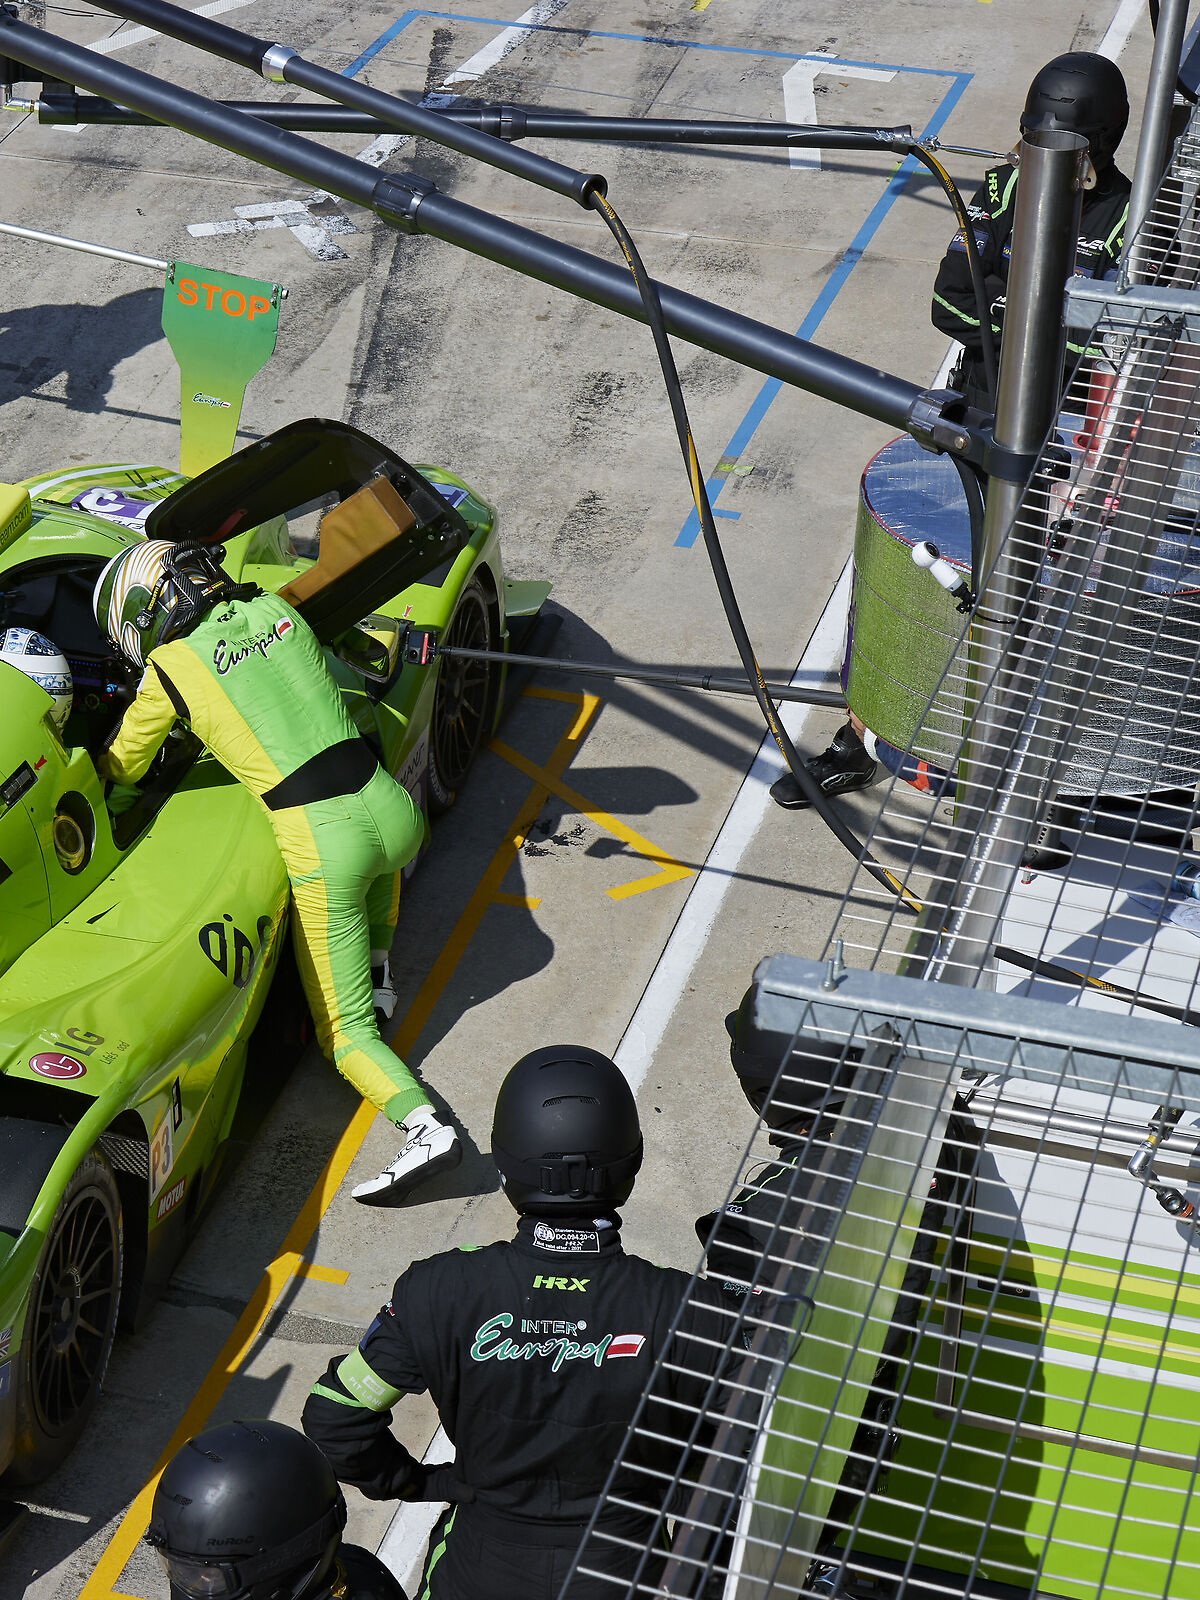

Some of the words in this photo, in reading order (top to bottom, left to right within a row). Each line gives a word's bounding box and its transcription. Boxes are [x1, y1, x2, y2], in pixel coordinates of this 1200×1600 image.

[988, 172, 1000, 203] HRX
[177, 278, 270, 321] STOP
[213, 623, 284, 676] Europol
[54, 1027, 105, 1057] LG
[152, 1125, 171, 1194] P3
[158, 1179, 185, 1218] MOTUL
[533, 1275, 590, 1292] HRX
[470, 1312, 613, 1373] Europol
[349, 1376, 362, 1391] PIT
[361, 1391, 383, 1408] LANE
